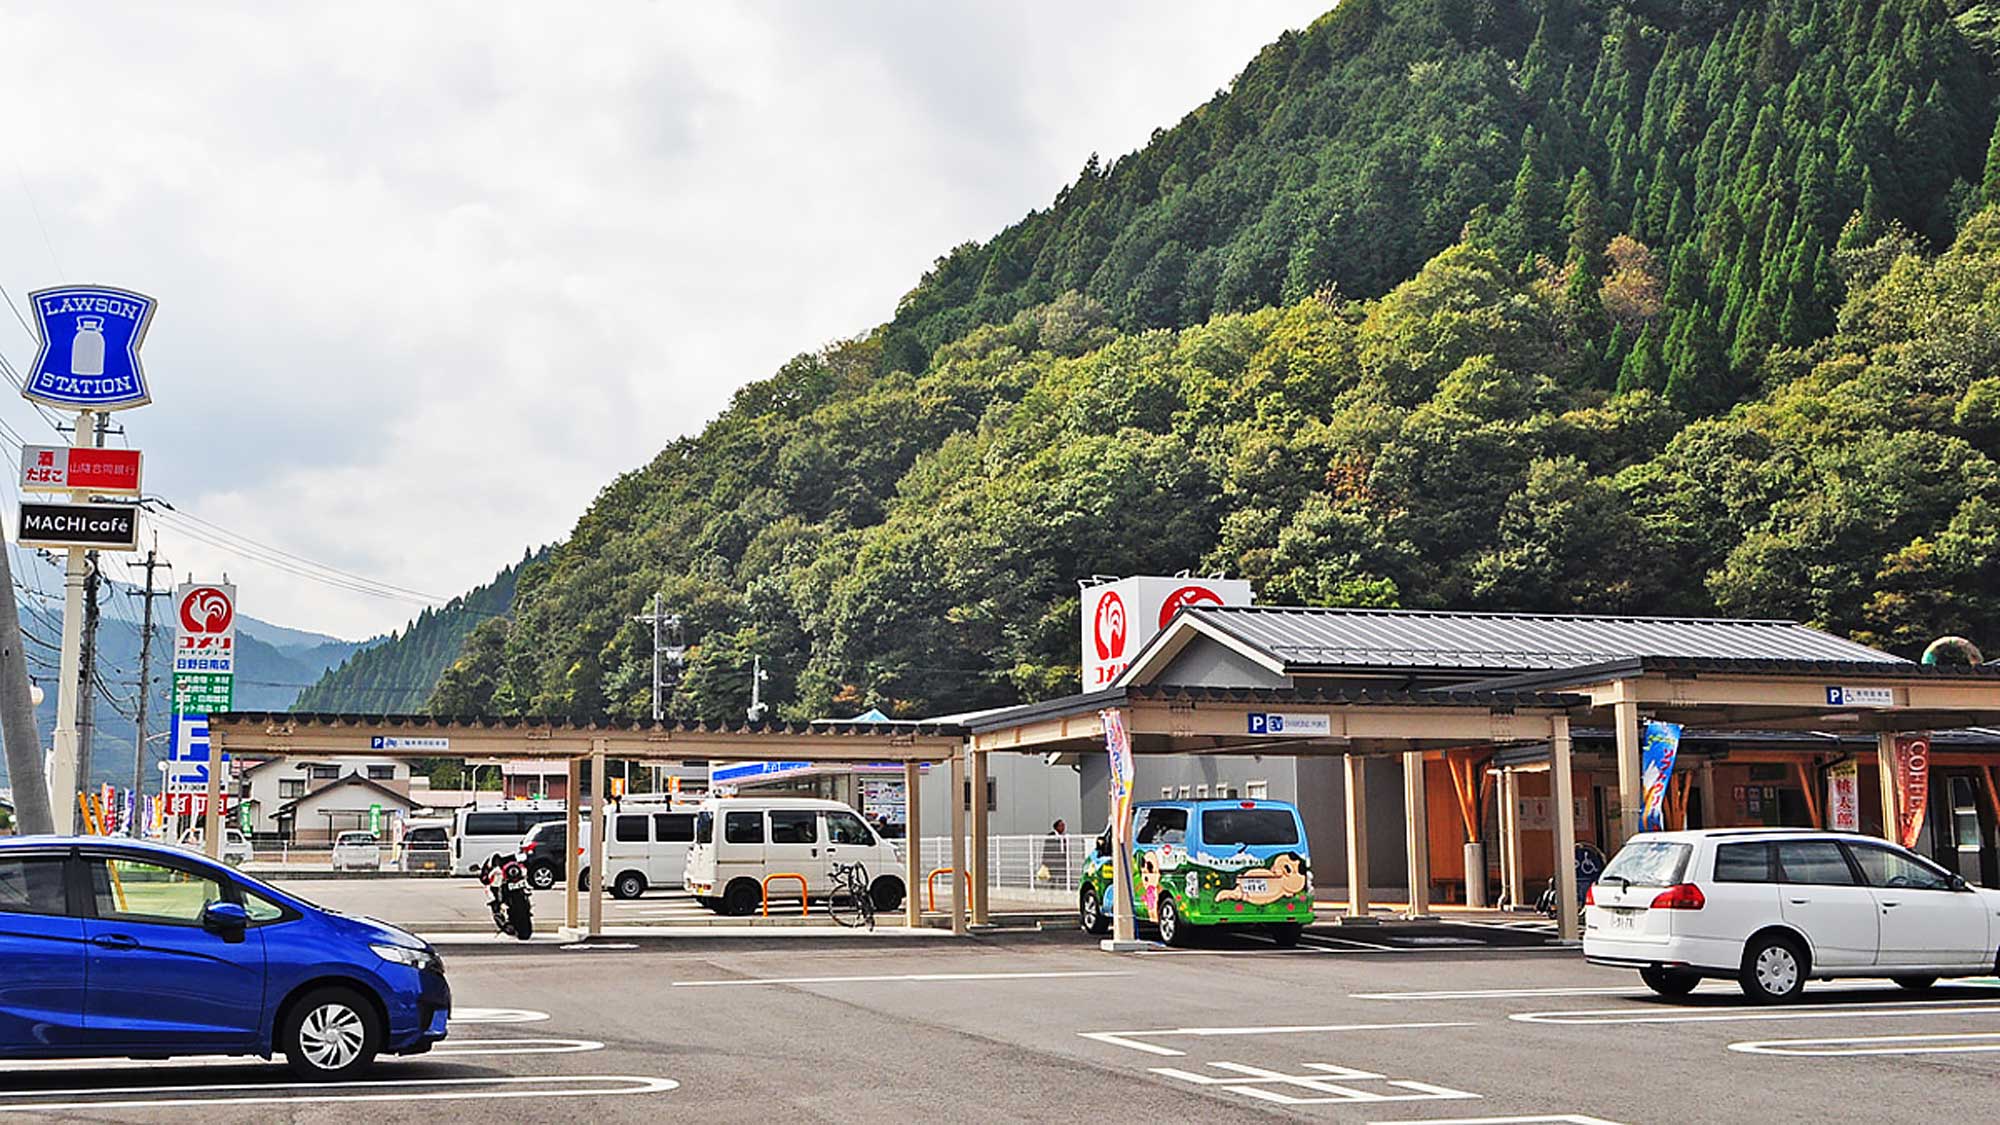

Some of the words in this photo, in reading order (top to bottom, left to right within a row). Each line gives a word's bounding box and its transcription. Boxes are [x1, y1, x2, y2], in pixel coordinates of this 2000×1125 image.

[43, 297, 139, 320] LAWSON
[40, 372, 133, 395] STATION
[26, 467, 63, 483] たばこ
[24, 515, 86, 532] MACHI
[89, 516, 129, 533] café
[179, 636, 231, 649] コメリ
[1830, 689, 1840, 703] P
[1252, 716, 1264, 732] P
[374, 738, 382, 748] P
